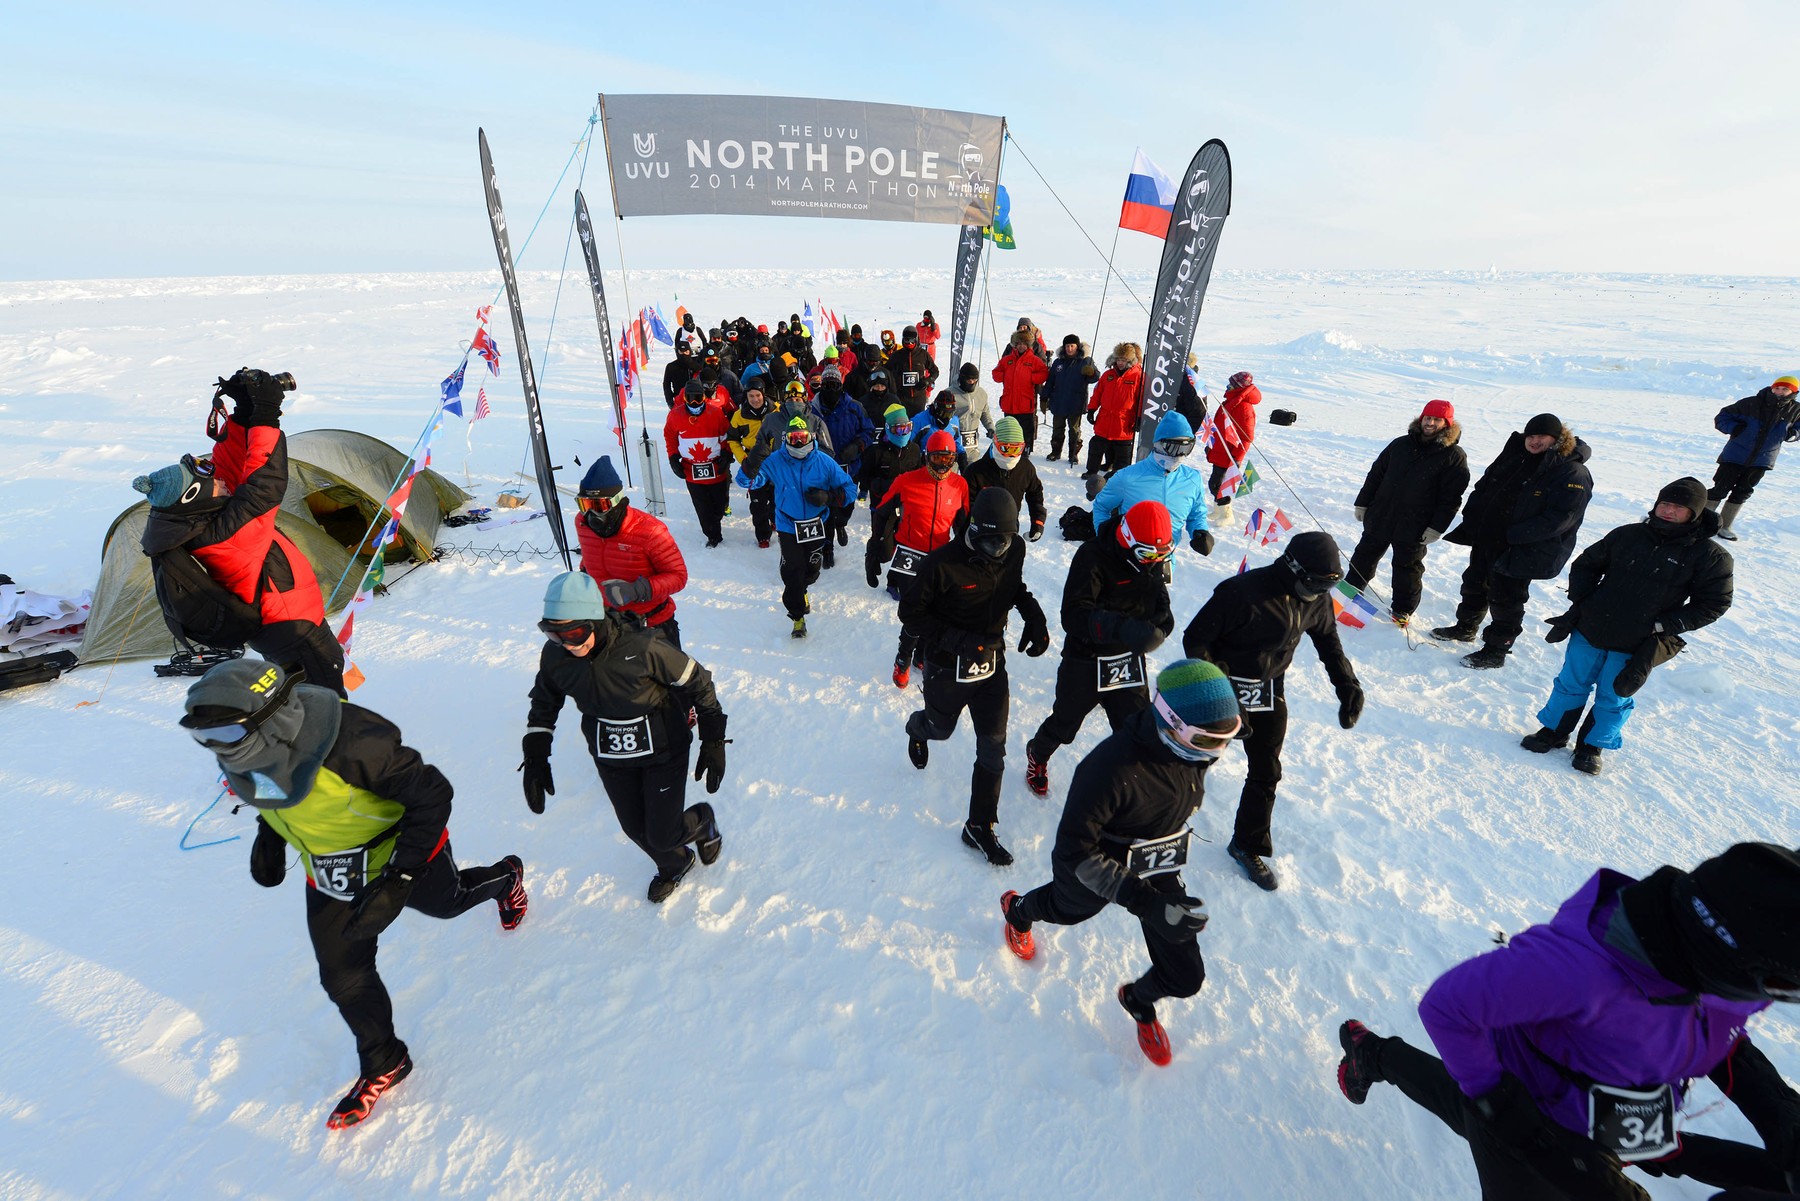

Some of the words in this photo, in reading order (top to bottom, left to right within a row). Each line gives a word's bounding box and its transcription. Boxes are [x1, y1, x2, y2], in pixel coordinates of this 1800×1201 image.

[779, 125, 812, 137] THE
[823, 127, 858, 140] UVU
[686, 139, 828, 173] NORTH
[845, 145, 939, 180] POLE
[625, 162, 670, 179] UVU
[689, 173, 756, 190] 2014
[776, 175, 938, 199] MARATHON
[974, 182, 990, 195] Pole
[771, 200, 868, 210] NORTHPOLEMARATHON.COM
[952, 292, 965, 355] NORTH
[1143, 313, 1178, 421] NORTH
[966, 436, 975, 446] 36
[697, 468, 710, 477] 30
[803, 525, 818, 538] 14
[902, 557, 913, 570] 3
[1109, 663, 1131, 684] 24
[1239, 688, 1262, 706] 22
[608, 733, 638, 751] 38
[1144, 848, 1177, 869] 12
[319, 866, 349, 892] 15
[1618, 1111, 1665, 1148] 34
